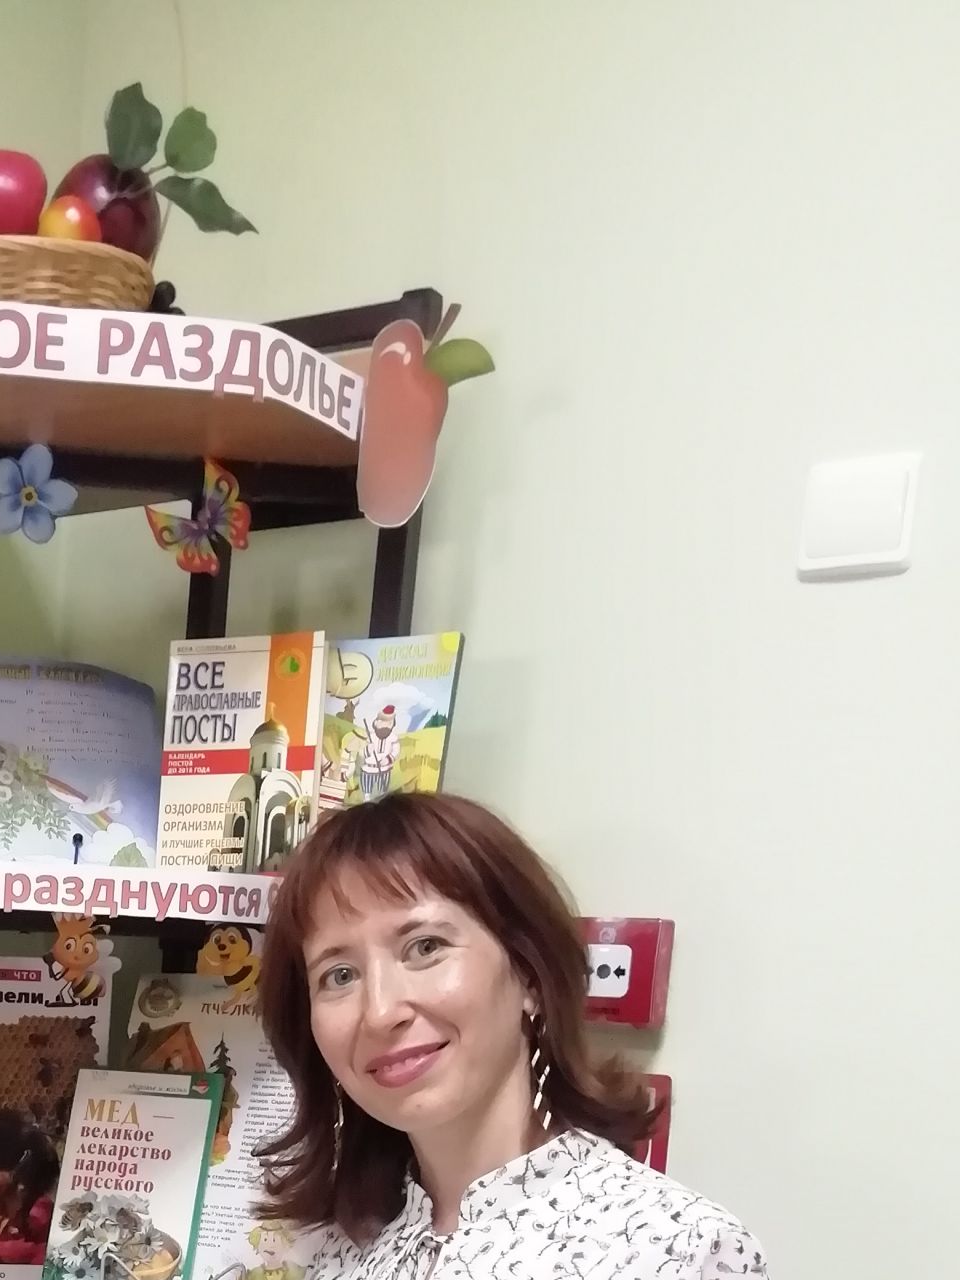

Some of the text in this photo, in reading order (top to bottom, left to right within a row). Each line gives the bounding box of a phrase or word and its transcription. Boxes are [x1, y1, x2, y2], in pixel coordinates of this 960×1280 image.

[96, 317, 357, 433] РАЗДОЛЬЕ
[176, 661, 226, 691] ВСЕ
[173, 691, 262, 712] ПРАВОСЛАВНЫЕ
[170, 713, 238, 745] ПОСТЫ
[168, 767, 177, 775] ДО
[164, 803, 245, 817] ОЗДОРОВЛЕНИЕ
[163, 821, 224, 833] ОРГАНИЗМА
[161, 840, 168, 849] И
[169, 840, 204, 850] ЛУЧШИЕ
[160, 853, 243, 868] ПОСТНОЙ ПИЩИ
[13, 971, 37, 980] ЧТО
[201, 1001, 258, 1017] ПЧЛК
[83, 1098, 140, 1128] МЕД
[80, 1125, 155, 1142] великое
[77, 1143, 172, 1161] лекарство
[74, 1158, 138, 1178] народа
[70, 1175, 155, 1194] русского
